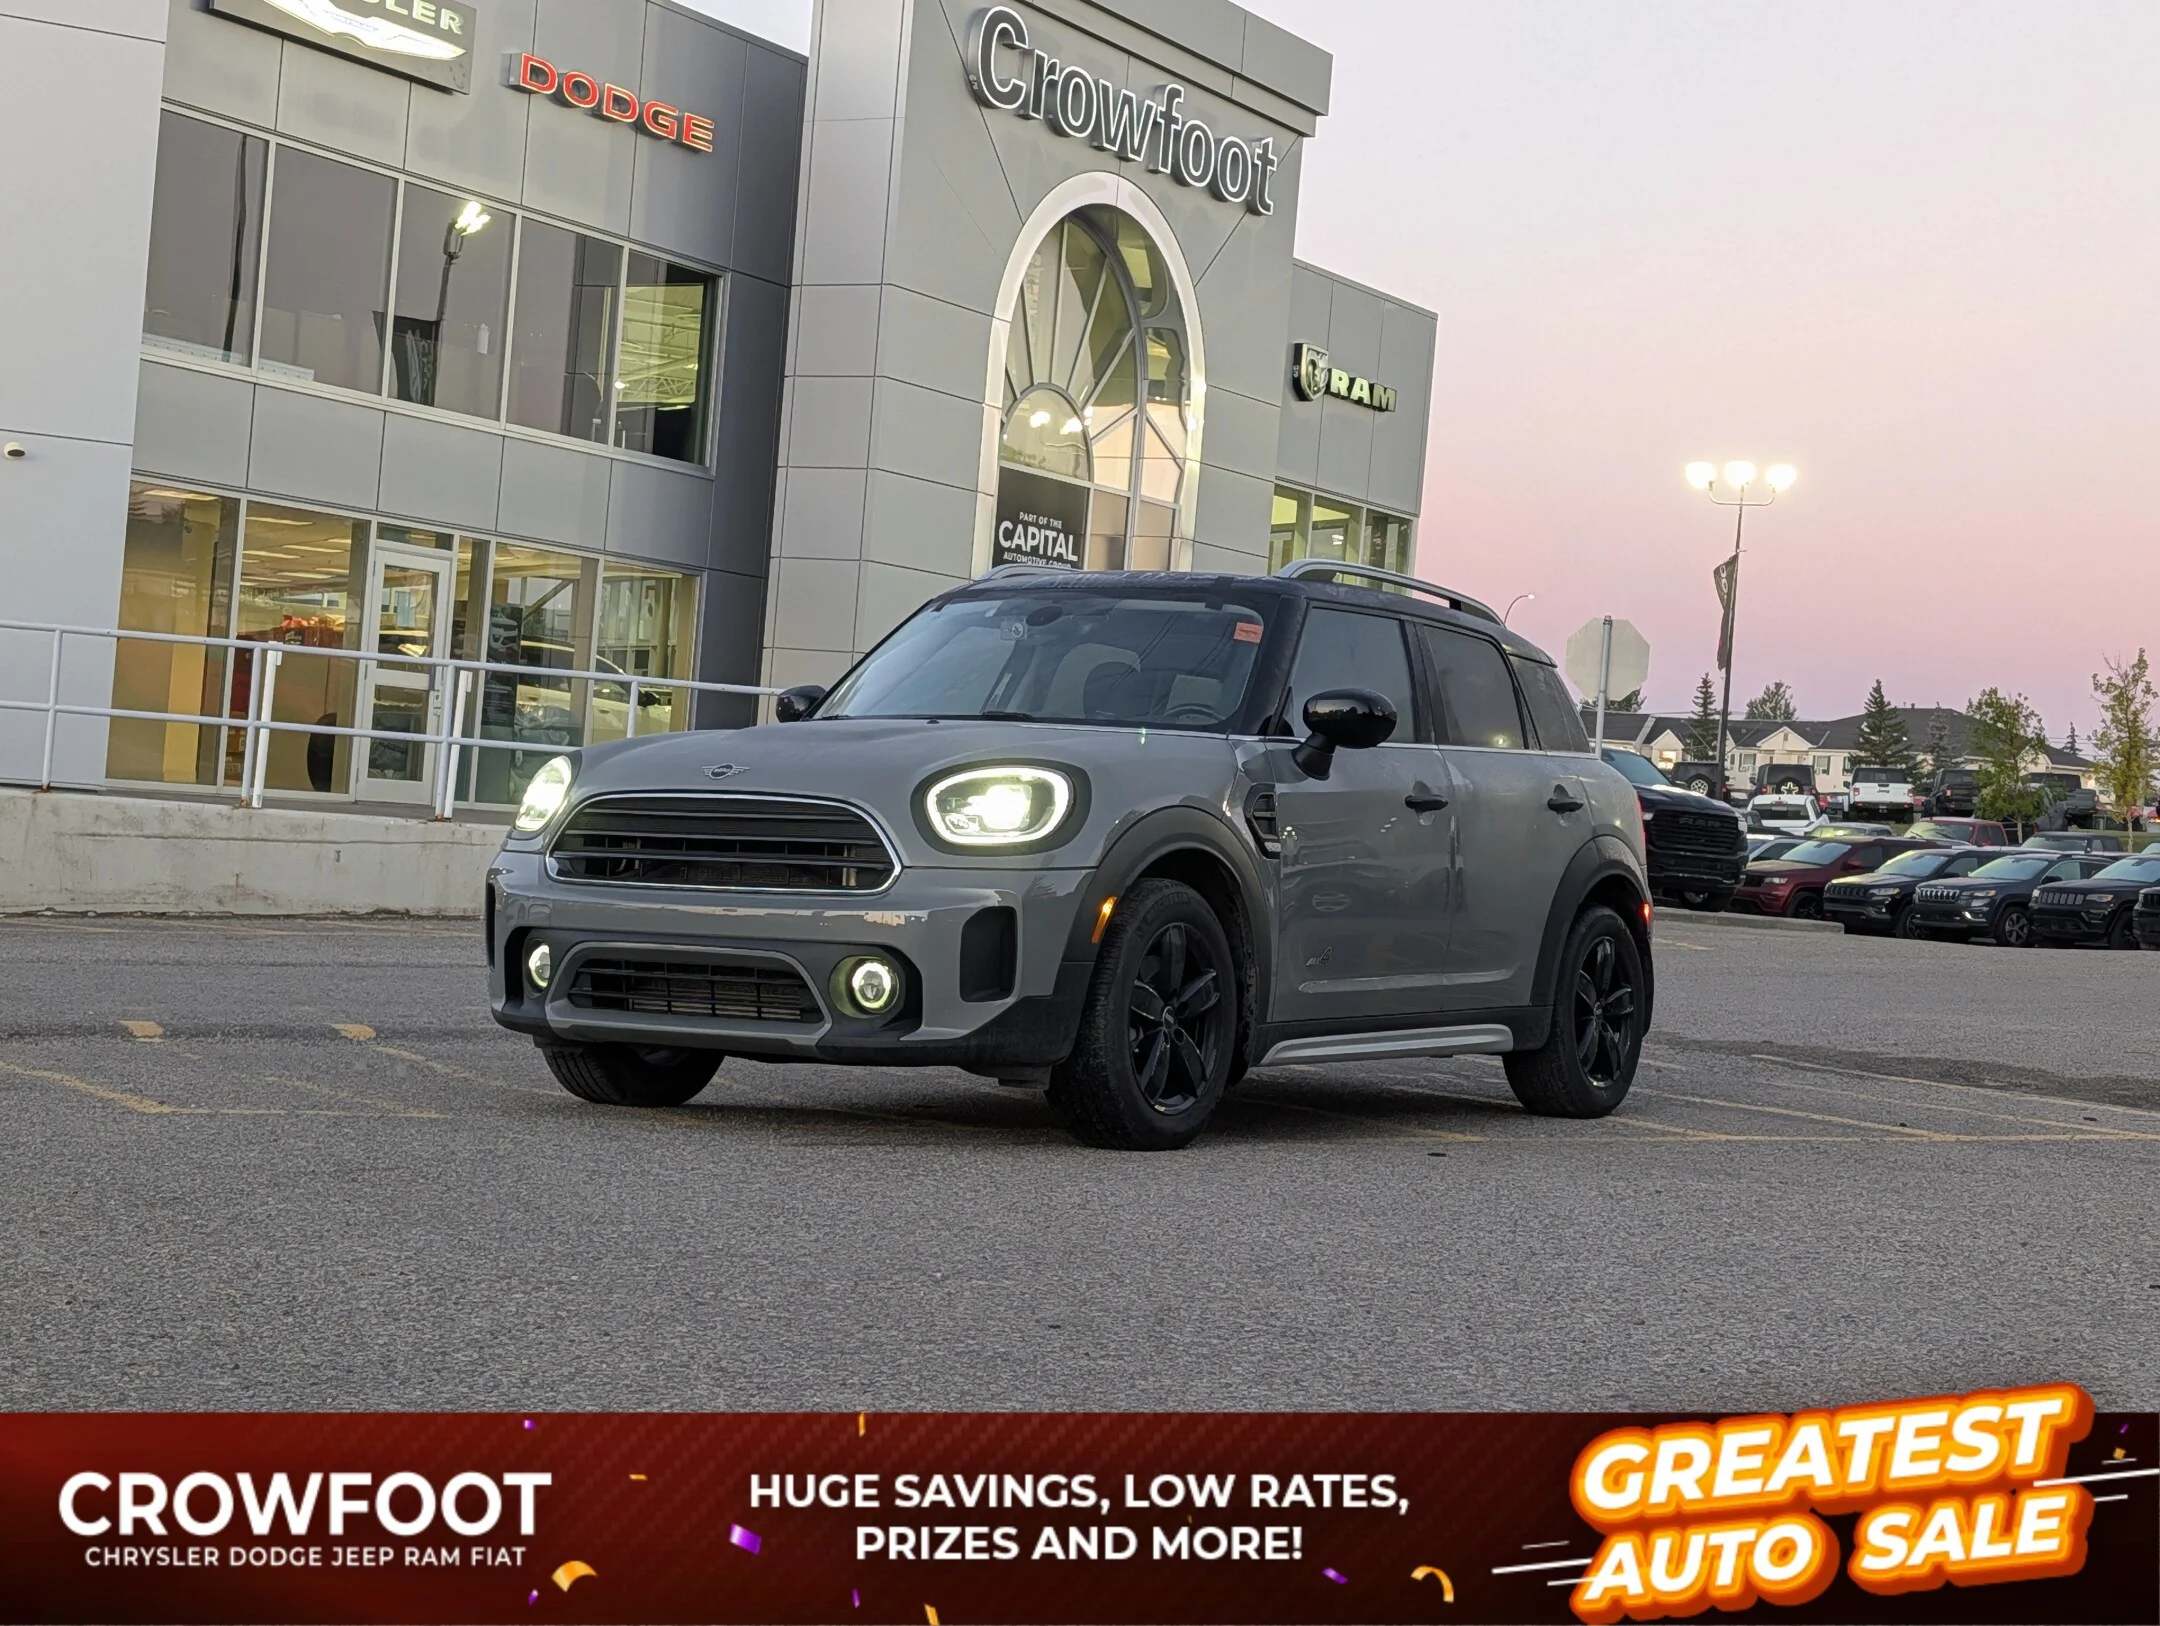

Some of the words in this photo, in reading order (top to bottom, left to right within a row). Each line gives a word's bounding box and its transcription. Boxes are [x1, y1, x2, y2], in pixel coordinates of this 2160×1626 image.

[520, 52, 715, 153] DODGE
[976, 5, 1278, 217] Crowfoot
[1329, 367, 1398, 412] RAM
[998, 520, 1079, 562] CAPITAL
[1019, 511, 1037, 523] PART
[1038, 516, 1048, 525] OF
[1049, 518, 1062, 529] THE
